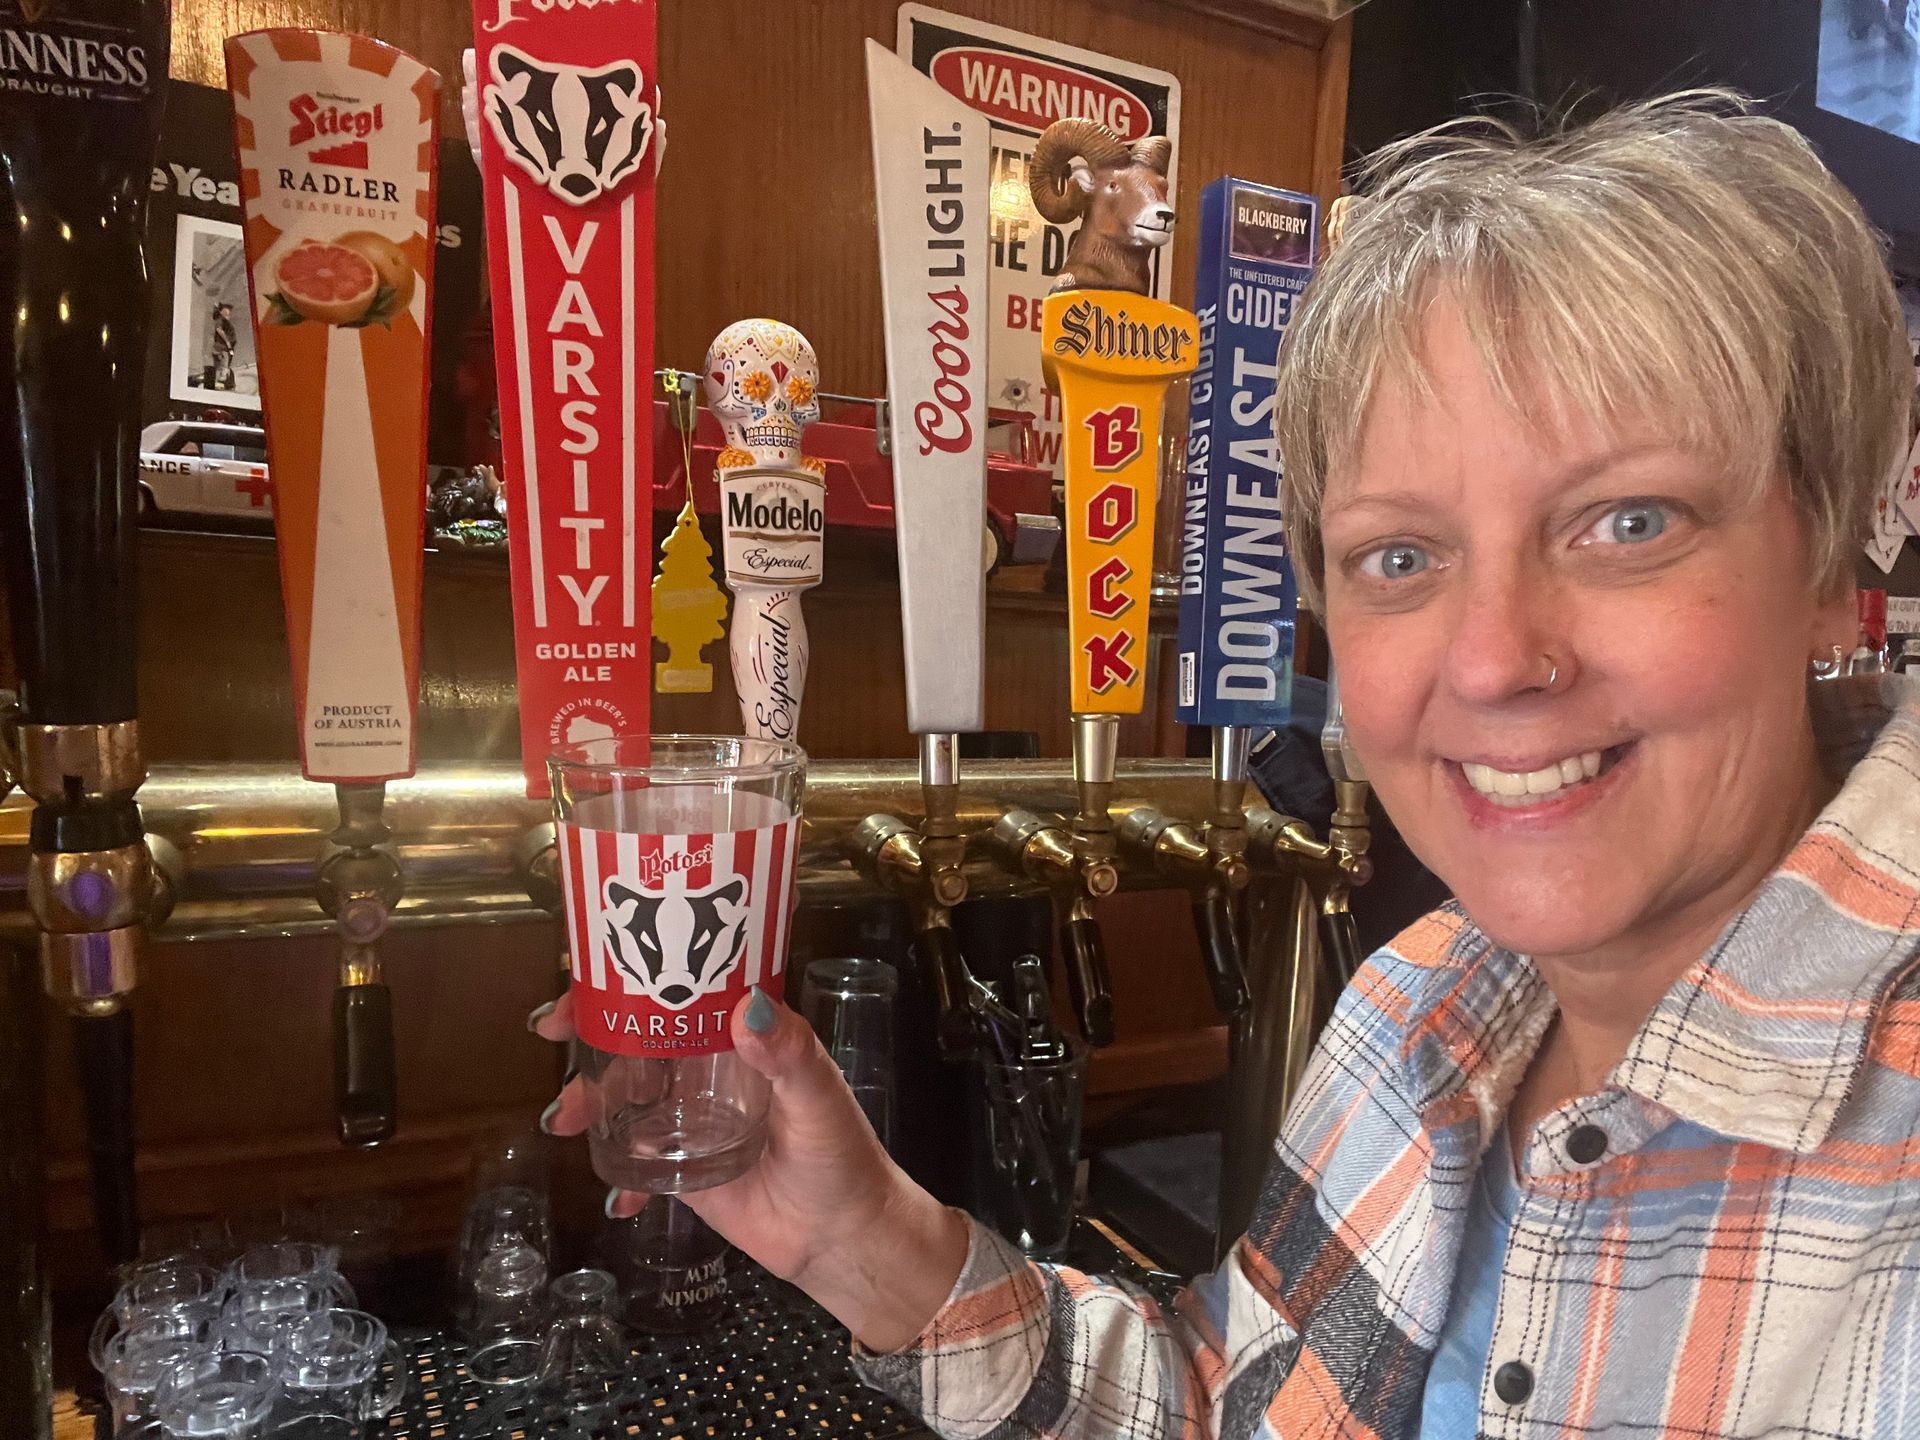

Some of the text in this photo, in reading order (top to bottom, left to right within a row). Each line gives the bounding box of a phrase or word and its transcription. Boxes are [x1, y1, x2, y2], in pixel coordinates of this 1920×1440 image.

[960, 56, 1131, 137] WARNING
[288, 93, 384, 147] Stiegl
[278, 168, 400, 203] RADLER
[281, 198, 398, 221] GRAPEFRUIT
[1238, 206, 1308, 235] BLACKBERRY
[914, 127, 974, 456] Coors LIGHT
[1229, 267, 1243, 279] THE
[1244, 270, 1286, 288] UNFILTERED
[1054, 300, 1191, 364] Shiner
[543, 215, 609, 626] VARSITY
[1181, 304, 1218, 596] DOWNEAST CIDER
[728, 492, 822, 532] Modelo
[743, 548, 811, 573] Especial
[1083, 404, 1142, 695] BOCK
[535, 643, 636, 659] GOLDEN
[563, 666, 612, 682] ALE
[755, 612, 797, 739] Especial
[314, 718, 402, 729] OF AUSTRIA
[323, 705, 392, 716] PRODUCT
[550, 698, 627, 745] BREWED IN BEER'S
[640, 843, 713, 885] Potosi
[642, 1038, 710, 1049] GOLDEN ALE
